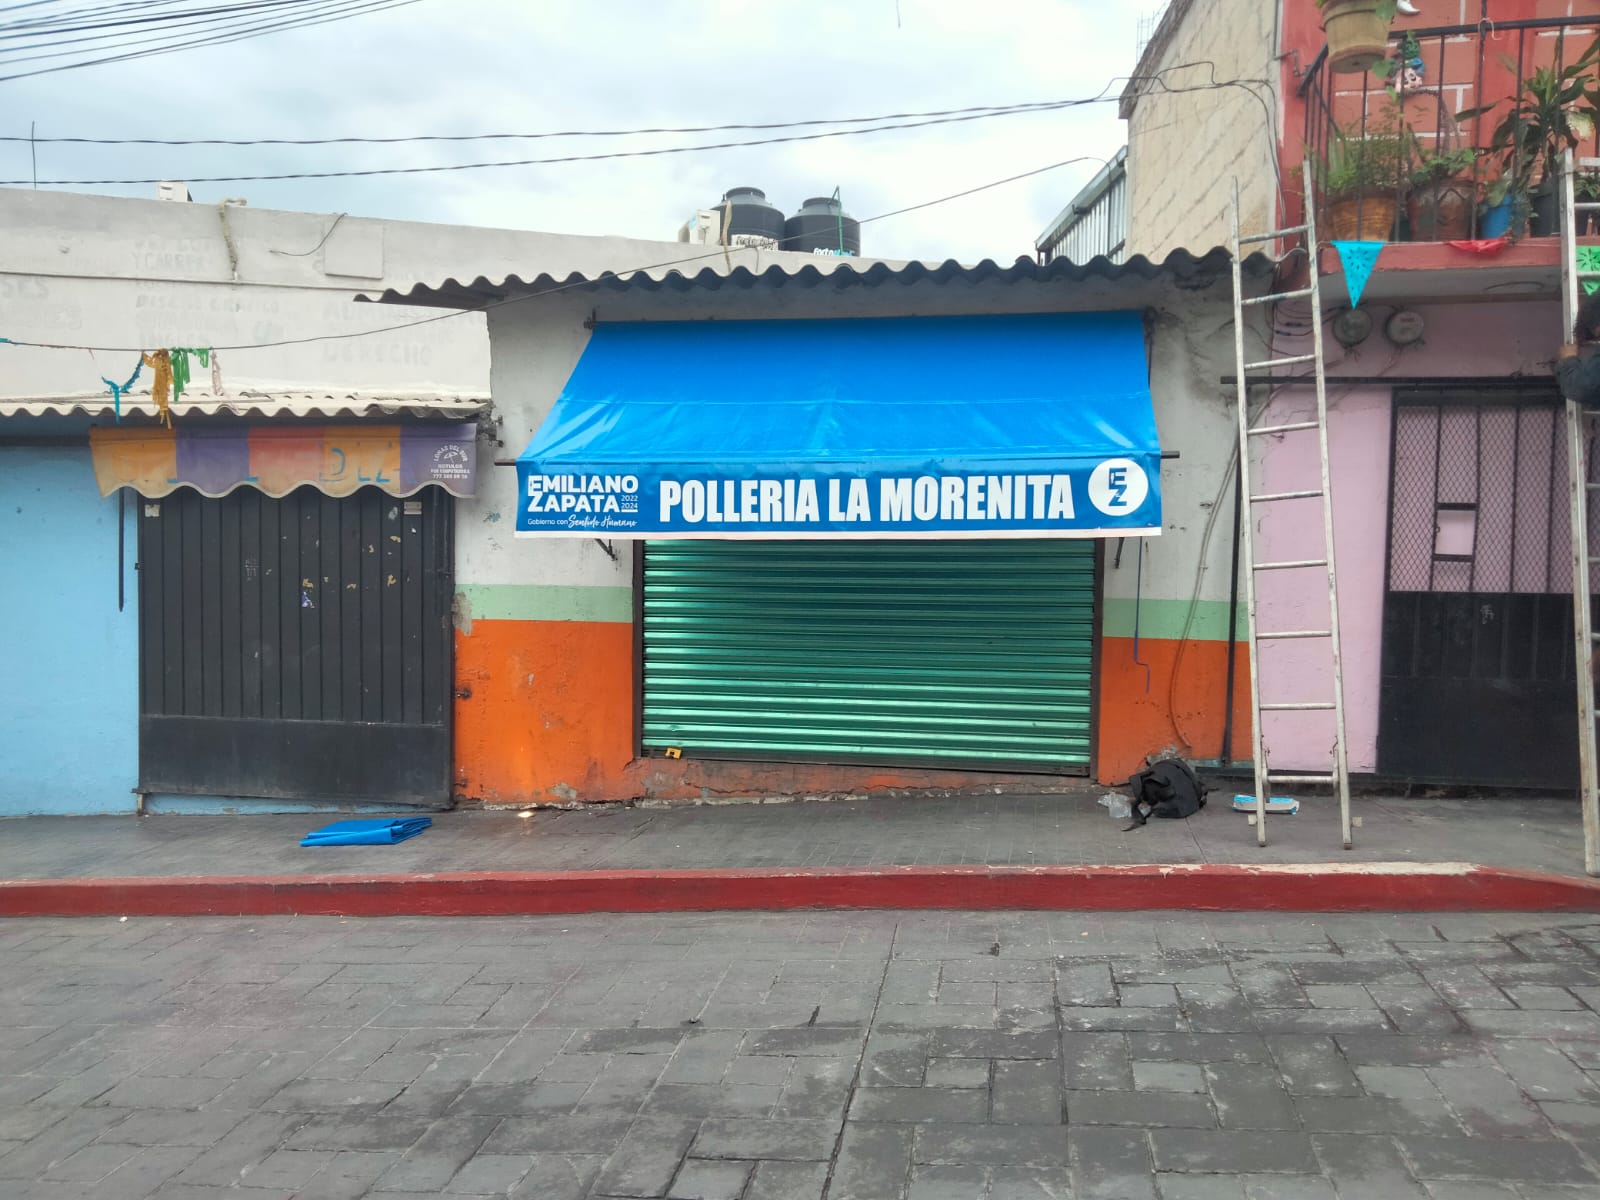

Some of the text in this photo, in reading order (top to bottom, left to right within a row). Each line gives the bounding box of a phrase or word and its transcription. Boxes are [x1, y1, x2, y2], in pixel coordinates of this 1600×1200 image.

[528, 475, 639, 496] EMILIANO
[528, 491, 620, 512] ZAPATA
[659, 475, 1075, 523] POLLERIA LA MORENITA
[568, 514, 600, 528] Sentido
[600, 514, 638, 529] Humano
